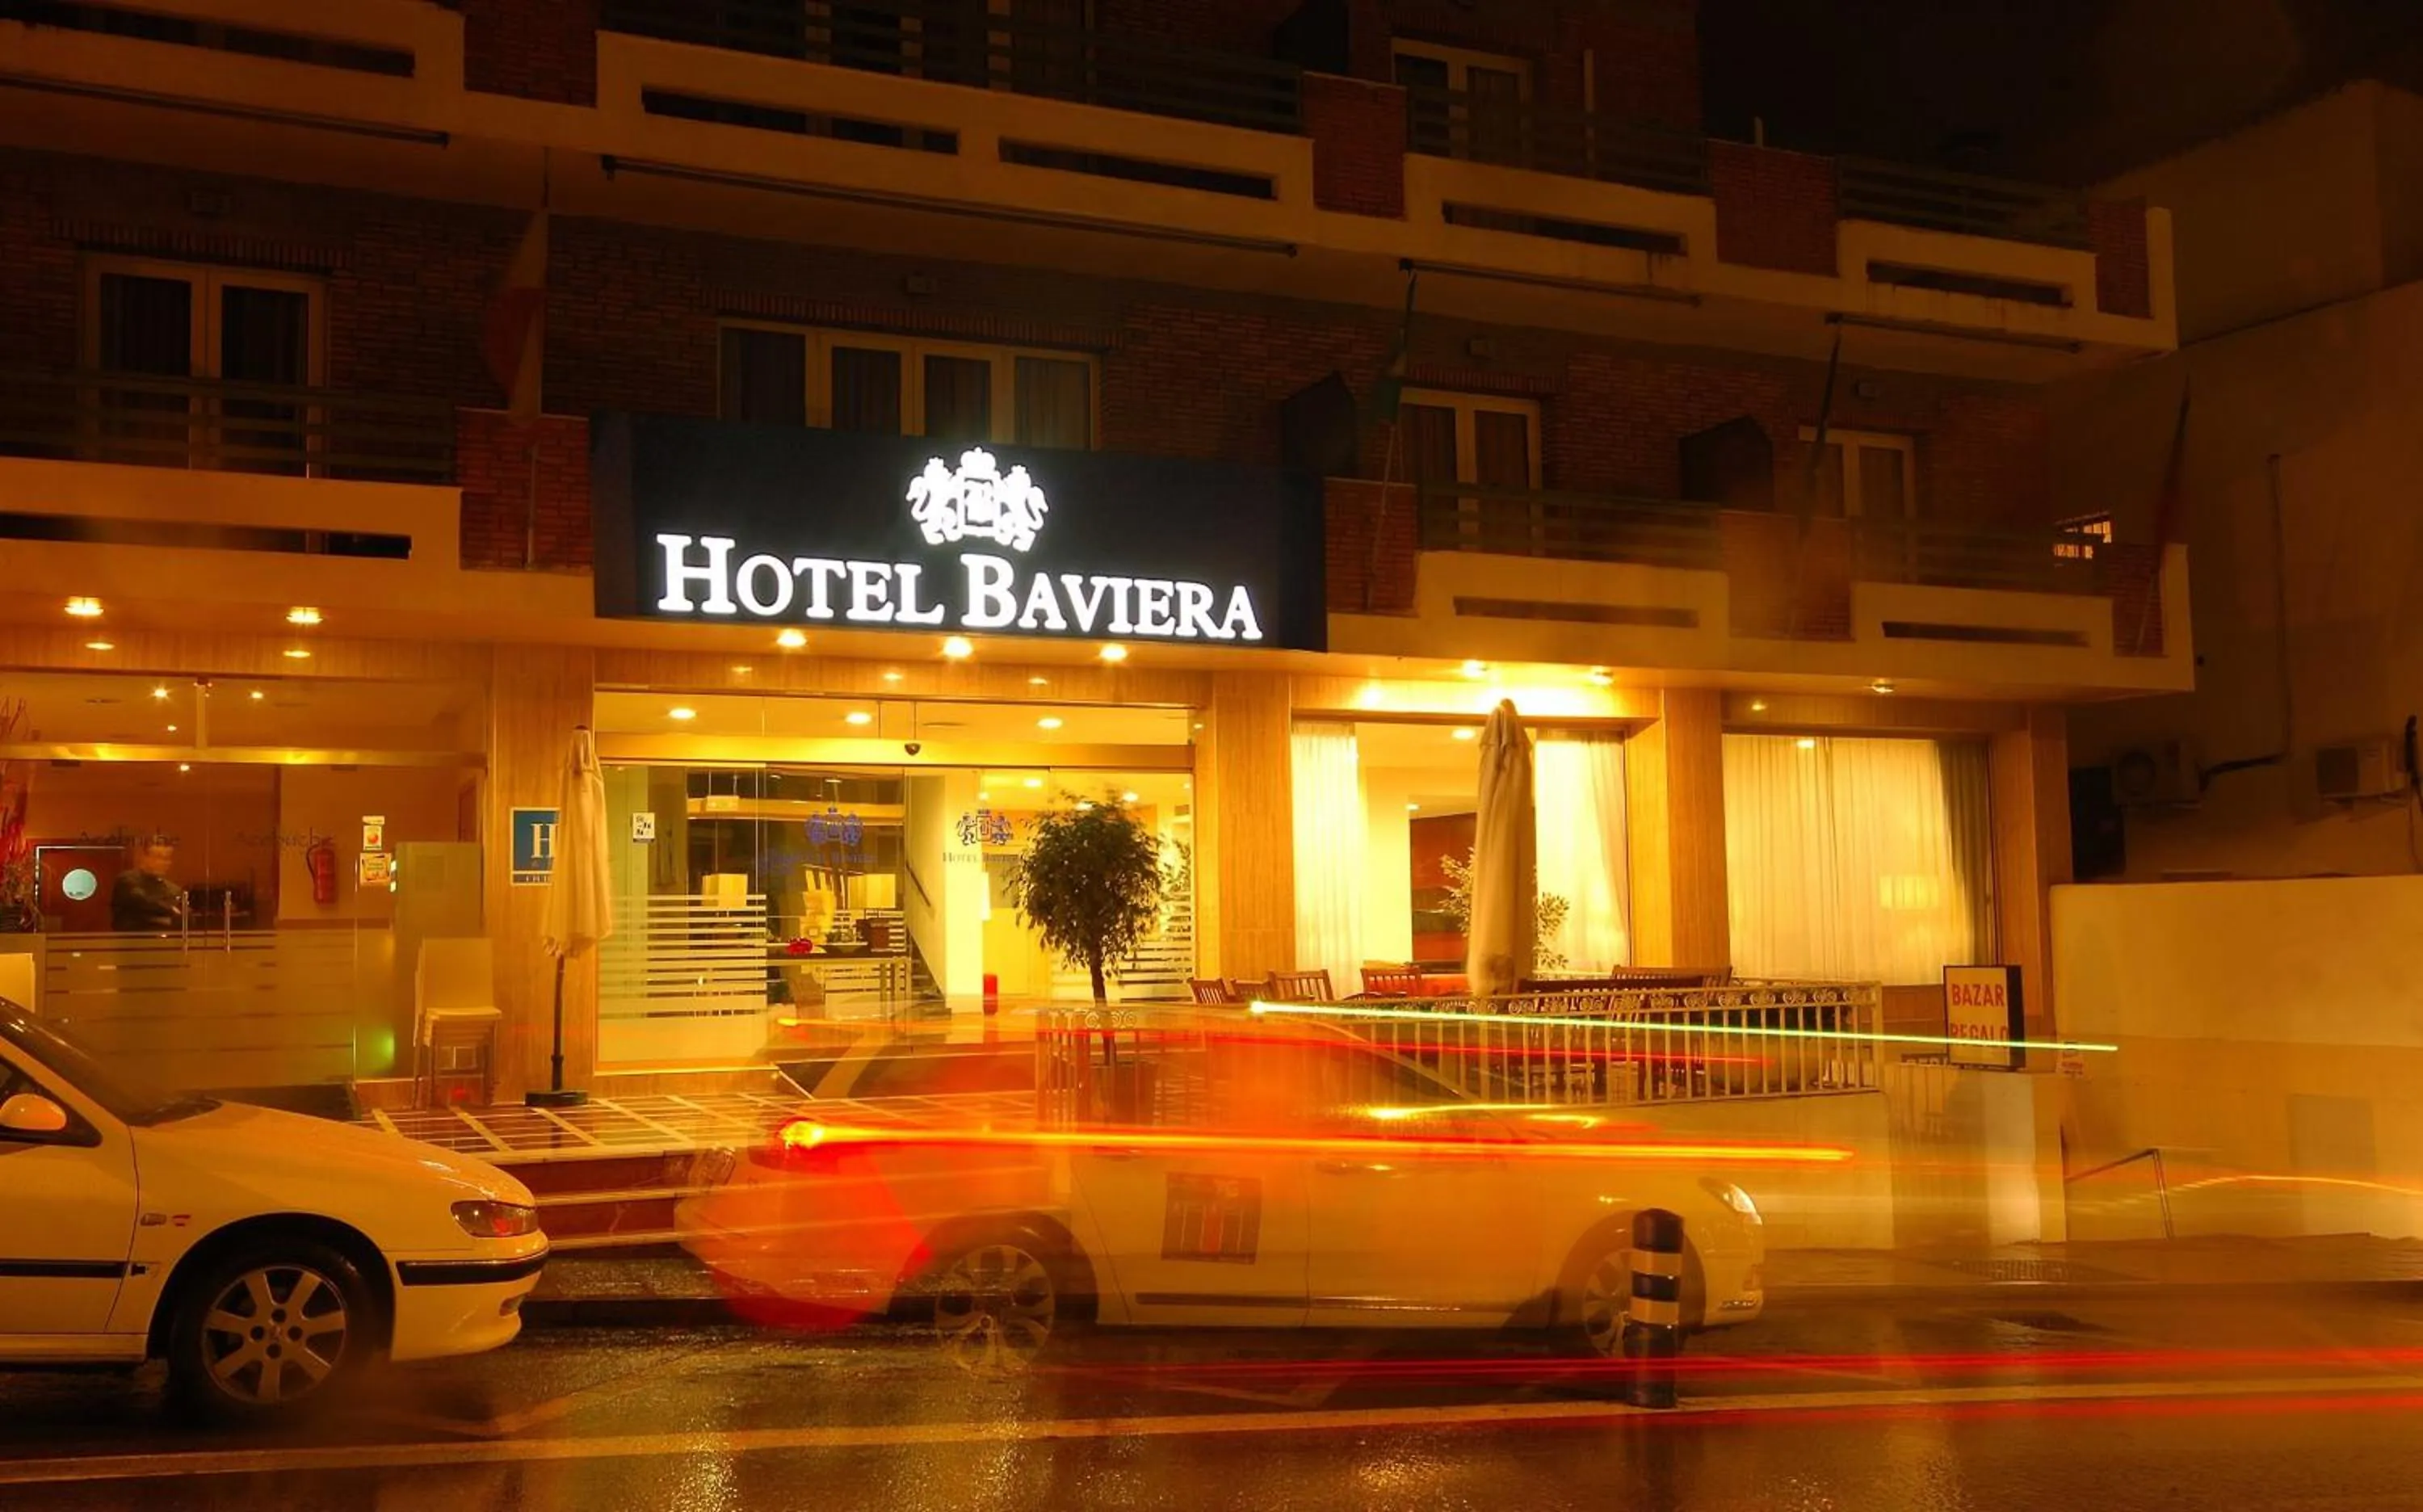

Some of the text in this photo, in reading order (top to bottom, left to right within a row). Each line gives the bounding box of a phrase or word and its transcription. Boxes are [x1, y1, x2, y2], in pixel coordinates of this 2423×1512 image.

[656, 533, 1264, 640] HOTEL BAVIERA
[1951, 983, 2005, 1006] BAZAR
